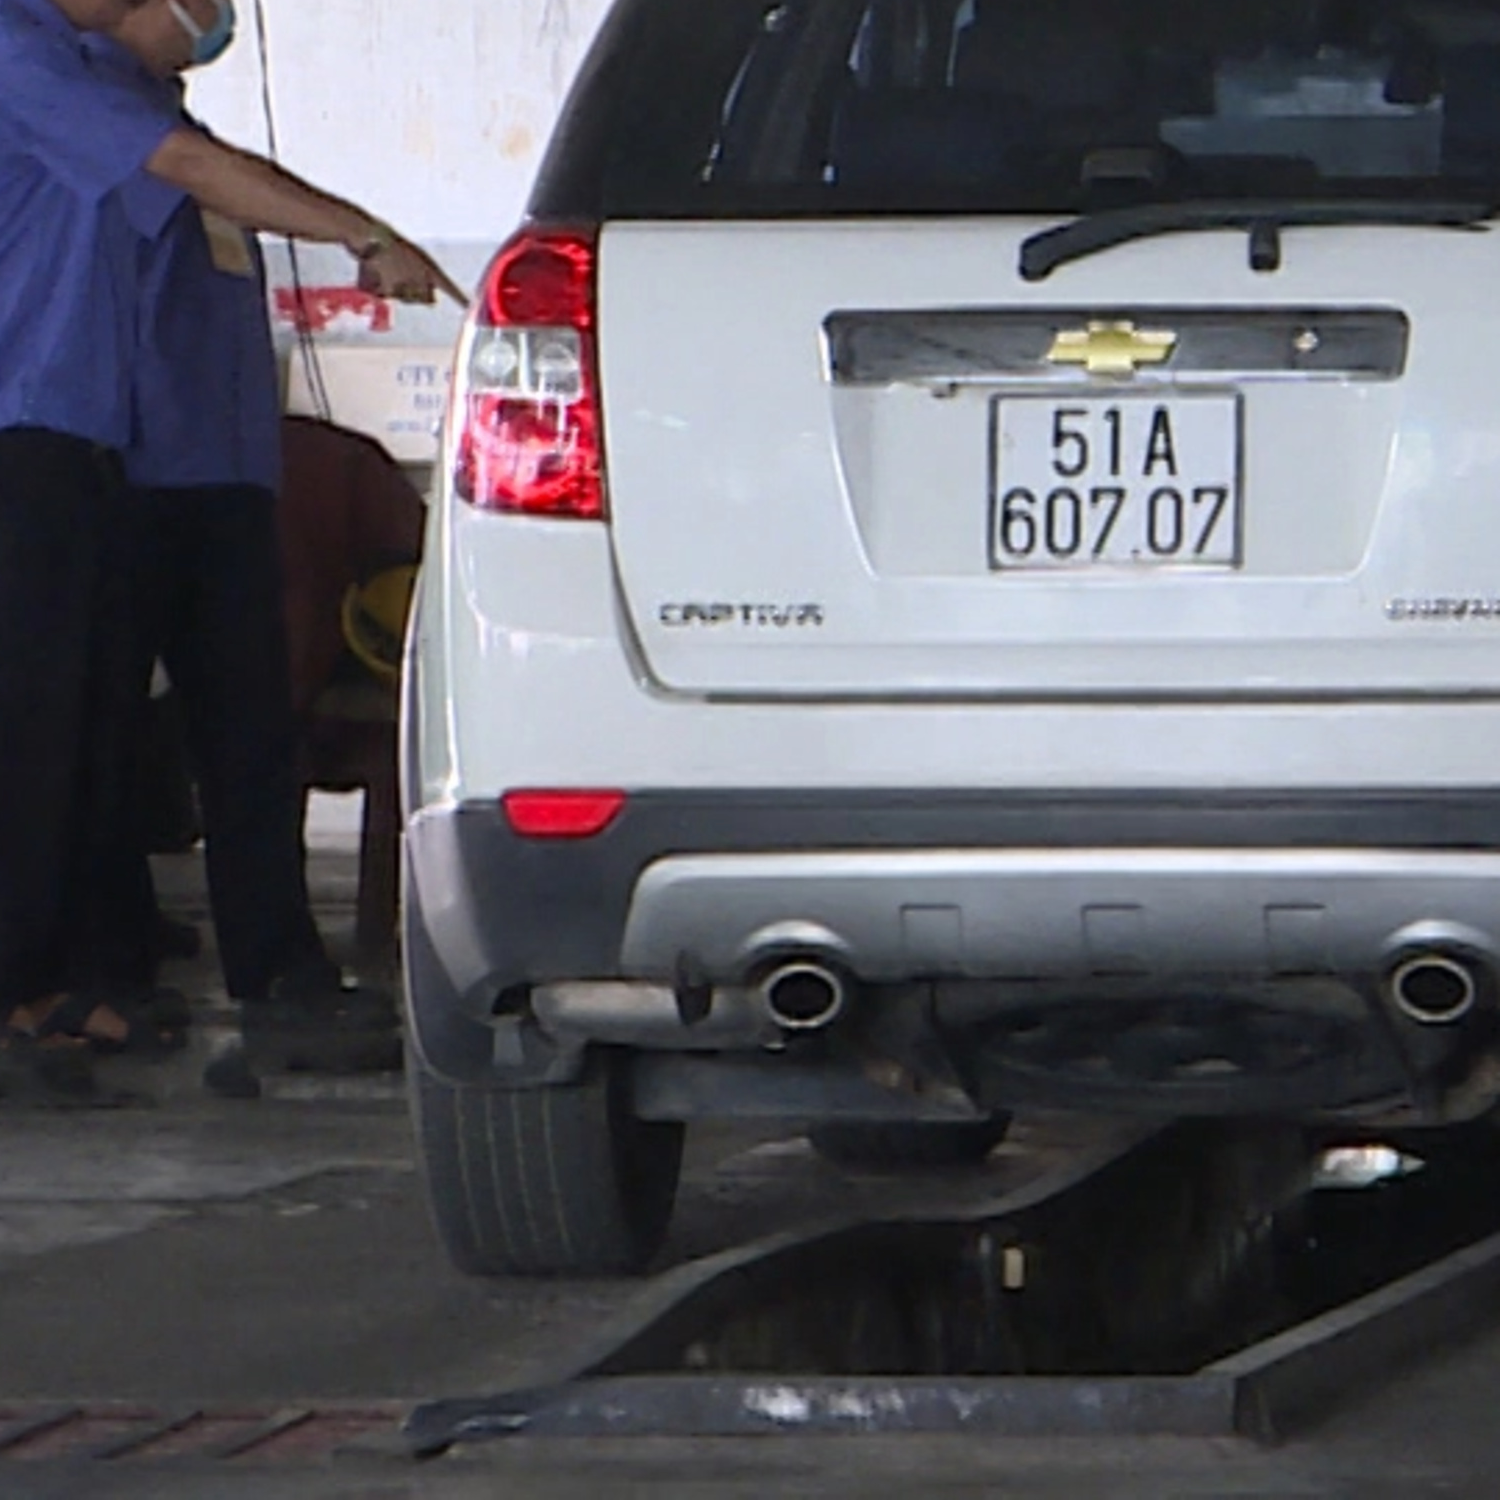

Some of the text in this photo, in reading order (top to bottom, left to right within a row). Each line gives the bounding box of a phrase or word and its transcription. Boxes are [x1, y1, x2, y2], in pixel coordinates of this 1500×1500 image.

[1051, 406, 1178, 477] 51A
[1000, 487, 1228, 556] 607.07
[659, 603, 825, 626] CAPTIVA
